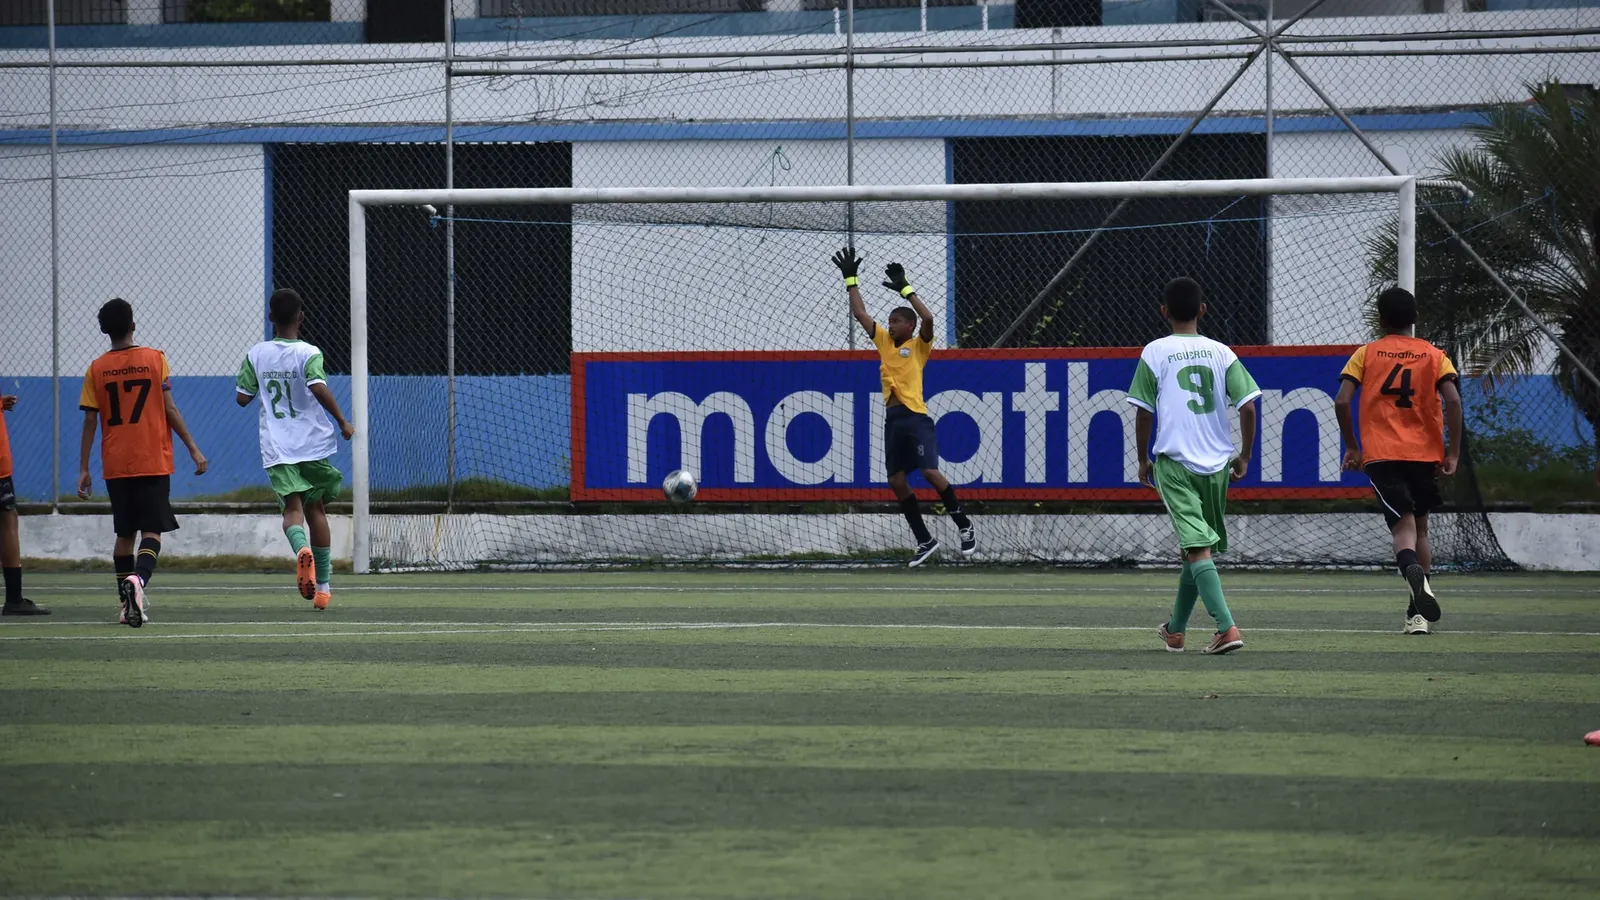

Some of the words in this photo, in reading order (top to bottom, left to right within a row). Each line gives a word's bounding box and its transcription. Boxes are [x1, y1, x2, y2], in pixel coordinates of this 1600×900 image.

[102, 365, 150, 378] marathon
[1377, 350, 1427, 360] marathon
[104, 379, 151, 426] 17
[266, 379, 296, 419] 21
[1176, 365, 1215, 415] 9
[1381, 363, 1415, 408] 4
[628, 361, 1341, 484] marathn
